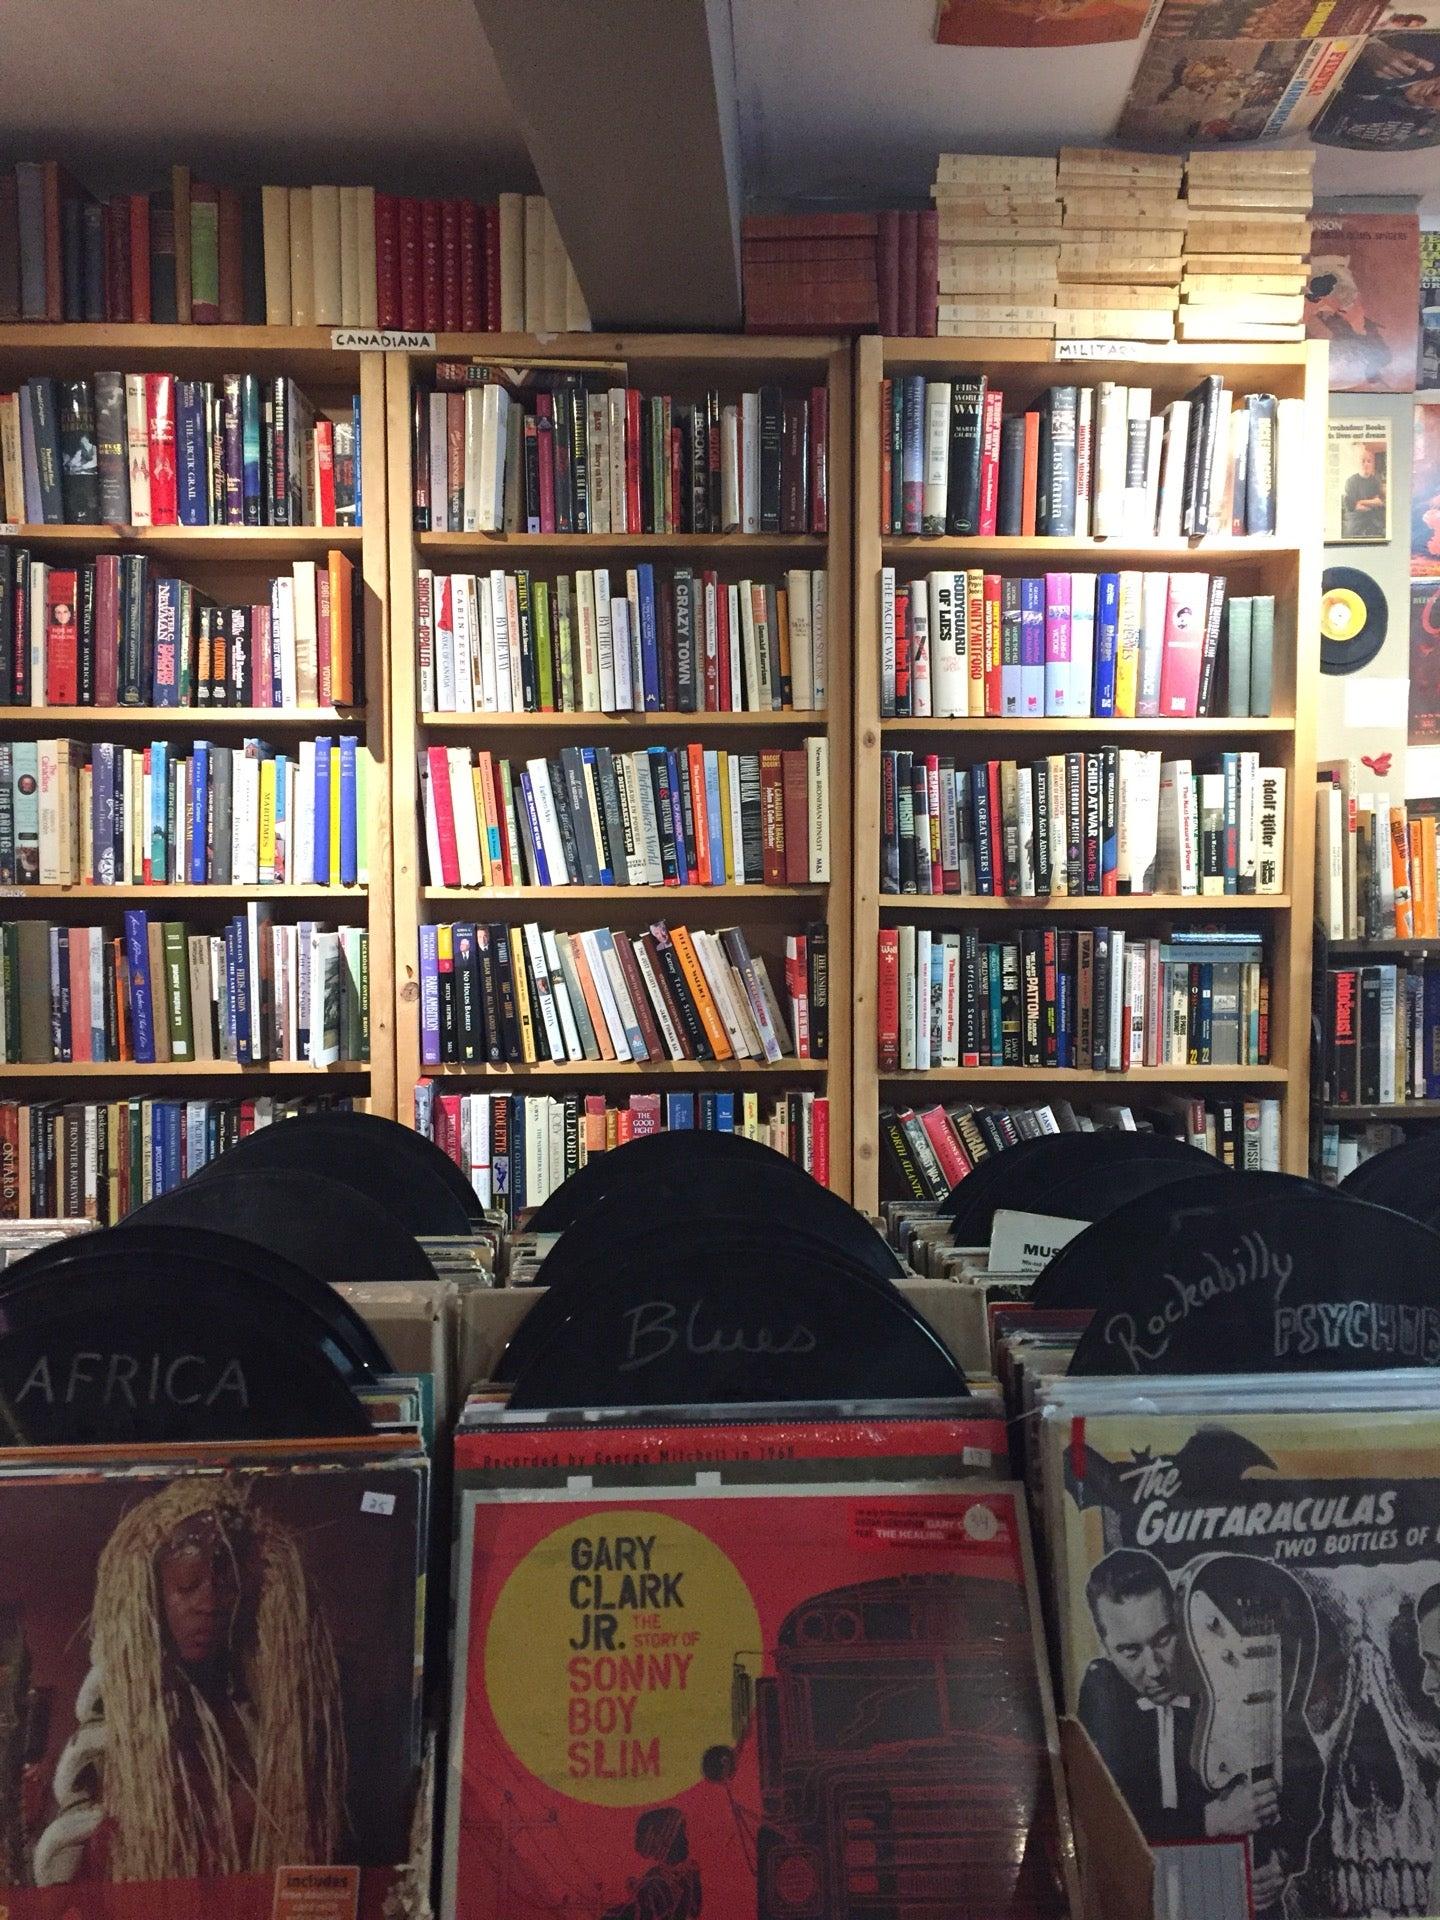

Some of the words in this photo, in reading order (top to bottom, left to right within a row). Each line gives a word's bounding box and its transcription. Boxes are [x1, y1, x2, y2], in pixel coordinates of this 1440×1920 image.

[335, 333, 431, 349] CANADIANA
[185, 420, 193, 438] THE
[993, 401, 1001, 428] SHORT
[187, 440, 195, 469] ARCTIC
[594, 444, 603, 468] History
[188, 472, 196, 500] GRAIL
[215, 471, 228, 501] Home
[306, 458, 315, 486] National
[1052, 441, 1074, 519] Lusitania
[452, 492, 460, 513] PAPERS
[17, 555, 27, 583] Newman
[884, 575, 892, 597] THE
[321, 580, 329, 617] 1867-1967
[417, 577, 430, 617] SHOCKED
[456, 589, 464, 629] CABIN
[518, 575, 527, 611] BETHUNE
[939, 589, 951, 606] OF
[157, 584, 170, 640] NEWMAN
[496, 616, 509, 630] BY
[598, 616, 610, 629] BY
[676, 585, 690, 636] CRAZY
[885, 601, 893, 644] PACIFIC
[939, 610, 951, 641] LIES
[954, 575, 965, 655] BODYGUARD
[971, 598, 982, 632] UNITY
[418, 625, 431, 667] APPALLED
[497, 632, 509, 652] THE
[599, 631, 611, 651] THE
[758, 625, 766, 651] Donald
[1105, 625, 1114, 661] Dieppe
[498, 654, 510, 671] WAY
[600, 652, 612, 671] WAY
[678, 641, 690, 685] TOWN
[759, 652, 767, 685] Morrison
[884, 647, 893, 672] WAR
[971, 632, 982, 680] MITFORD
[322, 666, 331, 697] CANADA
[42, 756, 50, 793] Canadians
[625, 765, 635, 804] RENEGADE
[1071, 765, 1079, 815] BATTLEGROUND
[1087, 759, 1098, 794] CHILD
[637, 768, 655, 833] Diefenbaker's
[774, 789, 783, 822] CANADIAN
[1088, 796, 1098, 810] AT
[1263, 779, 1277, 811] Adolf
[263, 792, 271, 847] MARITIMES
[618, 776, 630, 827] DIEFENBAKER
[625, 829, 633, 853] YEARS
[979, 808, 987, 834] GREAT
[1071, 817, 1080, 844] PACIFIC
[1088, 811, 1098, 837] WAR
[1260, 813, 1277, 848] Hitler
[645, 836, 660, 866] World
[663, 843, 676, 861] NASH
[776, 824, 784, 852] TRAGEDY
[980, 836, 988, 872] WATERS
[1088, 839, 1098, 863] Mark
[818, 954, 827, 970] THE
[1082, 940, 1090, 969] WAR
[425, 976, 437, 996] RARE
[818, 971, 826, 1008] INSIDERS
[1026, 977, 1040, 1019] PATTON
[175, 1017, 182, 1026] LE
[426, 997, 438, 1031] AMBITION
[464, 1005, 472, 1031] BARRED
[1337, 973, 1356, 1036] Holocaust
[1381, 996, 1393, 1015] LOST
[947, 1021, 955, 1043] Power
[967, 1009, 975, 1048] Secrets
[1082, 1008, 1090, 1054] MERCY
[98, 1108, 107, 1150] Saskatoon
[194, 1120, 204, 1147] PACIFIC
[447, 1114, 457, 1146] TRUDEAU
[494, 1100, 506, 1153] PIROUETTE
[566, 1101, 578, 1164] FULFORD
[957, 1113, 988, 1163] MORAL
[70, 1121, 78, 1168] FRONTIER
[946, 1135, 958, 1155] GUNS
[3, 1142, 14, 1198] ONTARIO
[887, 1125, 908, 1157] NORTH
[901, 1158, 927, 1199] ATLANTIC
[1105, 1230, 1293, 1373] Rockabilly
[619, 1300, 816, 1372] Blues
[15, 1352, 251, 1408] AFRICA
[482, 1453, 559, 1470] Recorded
[568, 1452, 586, 1470] by
[595, 1450, 650, 1468] George
[660, 1447, 727, 1465] Mitchell
[735, 1447, 750, 1462] in
[1120, 1461, 1182, 1504] The
[1136, 1490, 1398, 1546] GUITARACULAS
[571, 1536, 656, 1572] GARY
[1274, 1537, 1315, 1560] TWO
[1325, 1530, 1398, 1557] BOTTLES
[1405, 1526, 1430, 1547] OF
[570, 1571, 685, 1611] CLARK
[569, 1612, 627, 1651] JR.
[634, 1614, 661, 1631] THE
[634, 1631, 677, 1648] STORY
[681, 1631, 701, 1647] OF
[567, 1653, 694, 1694] SONNY
[568, 1695, 638, 1736] BOY
[567, 1738, 662, 1779] SLIM
